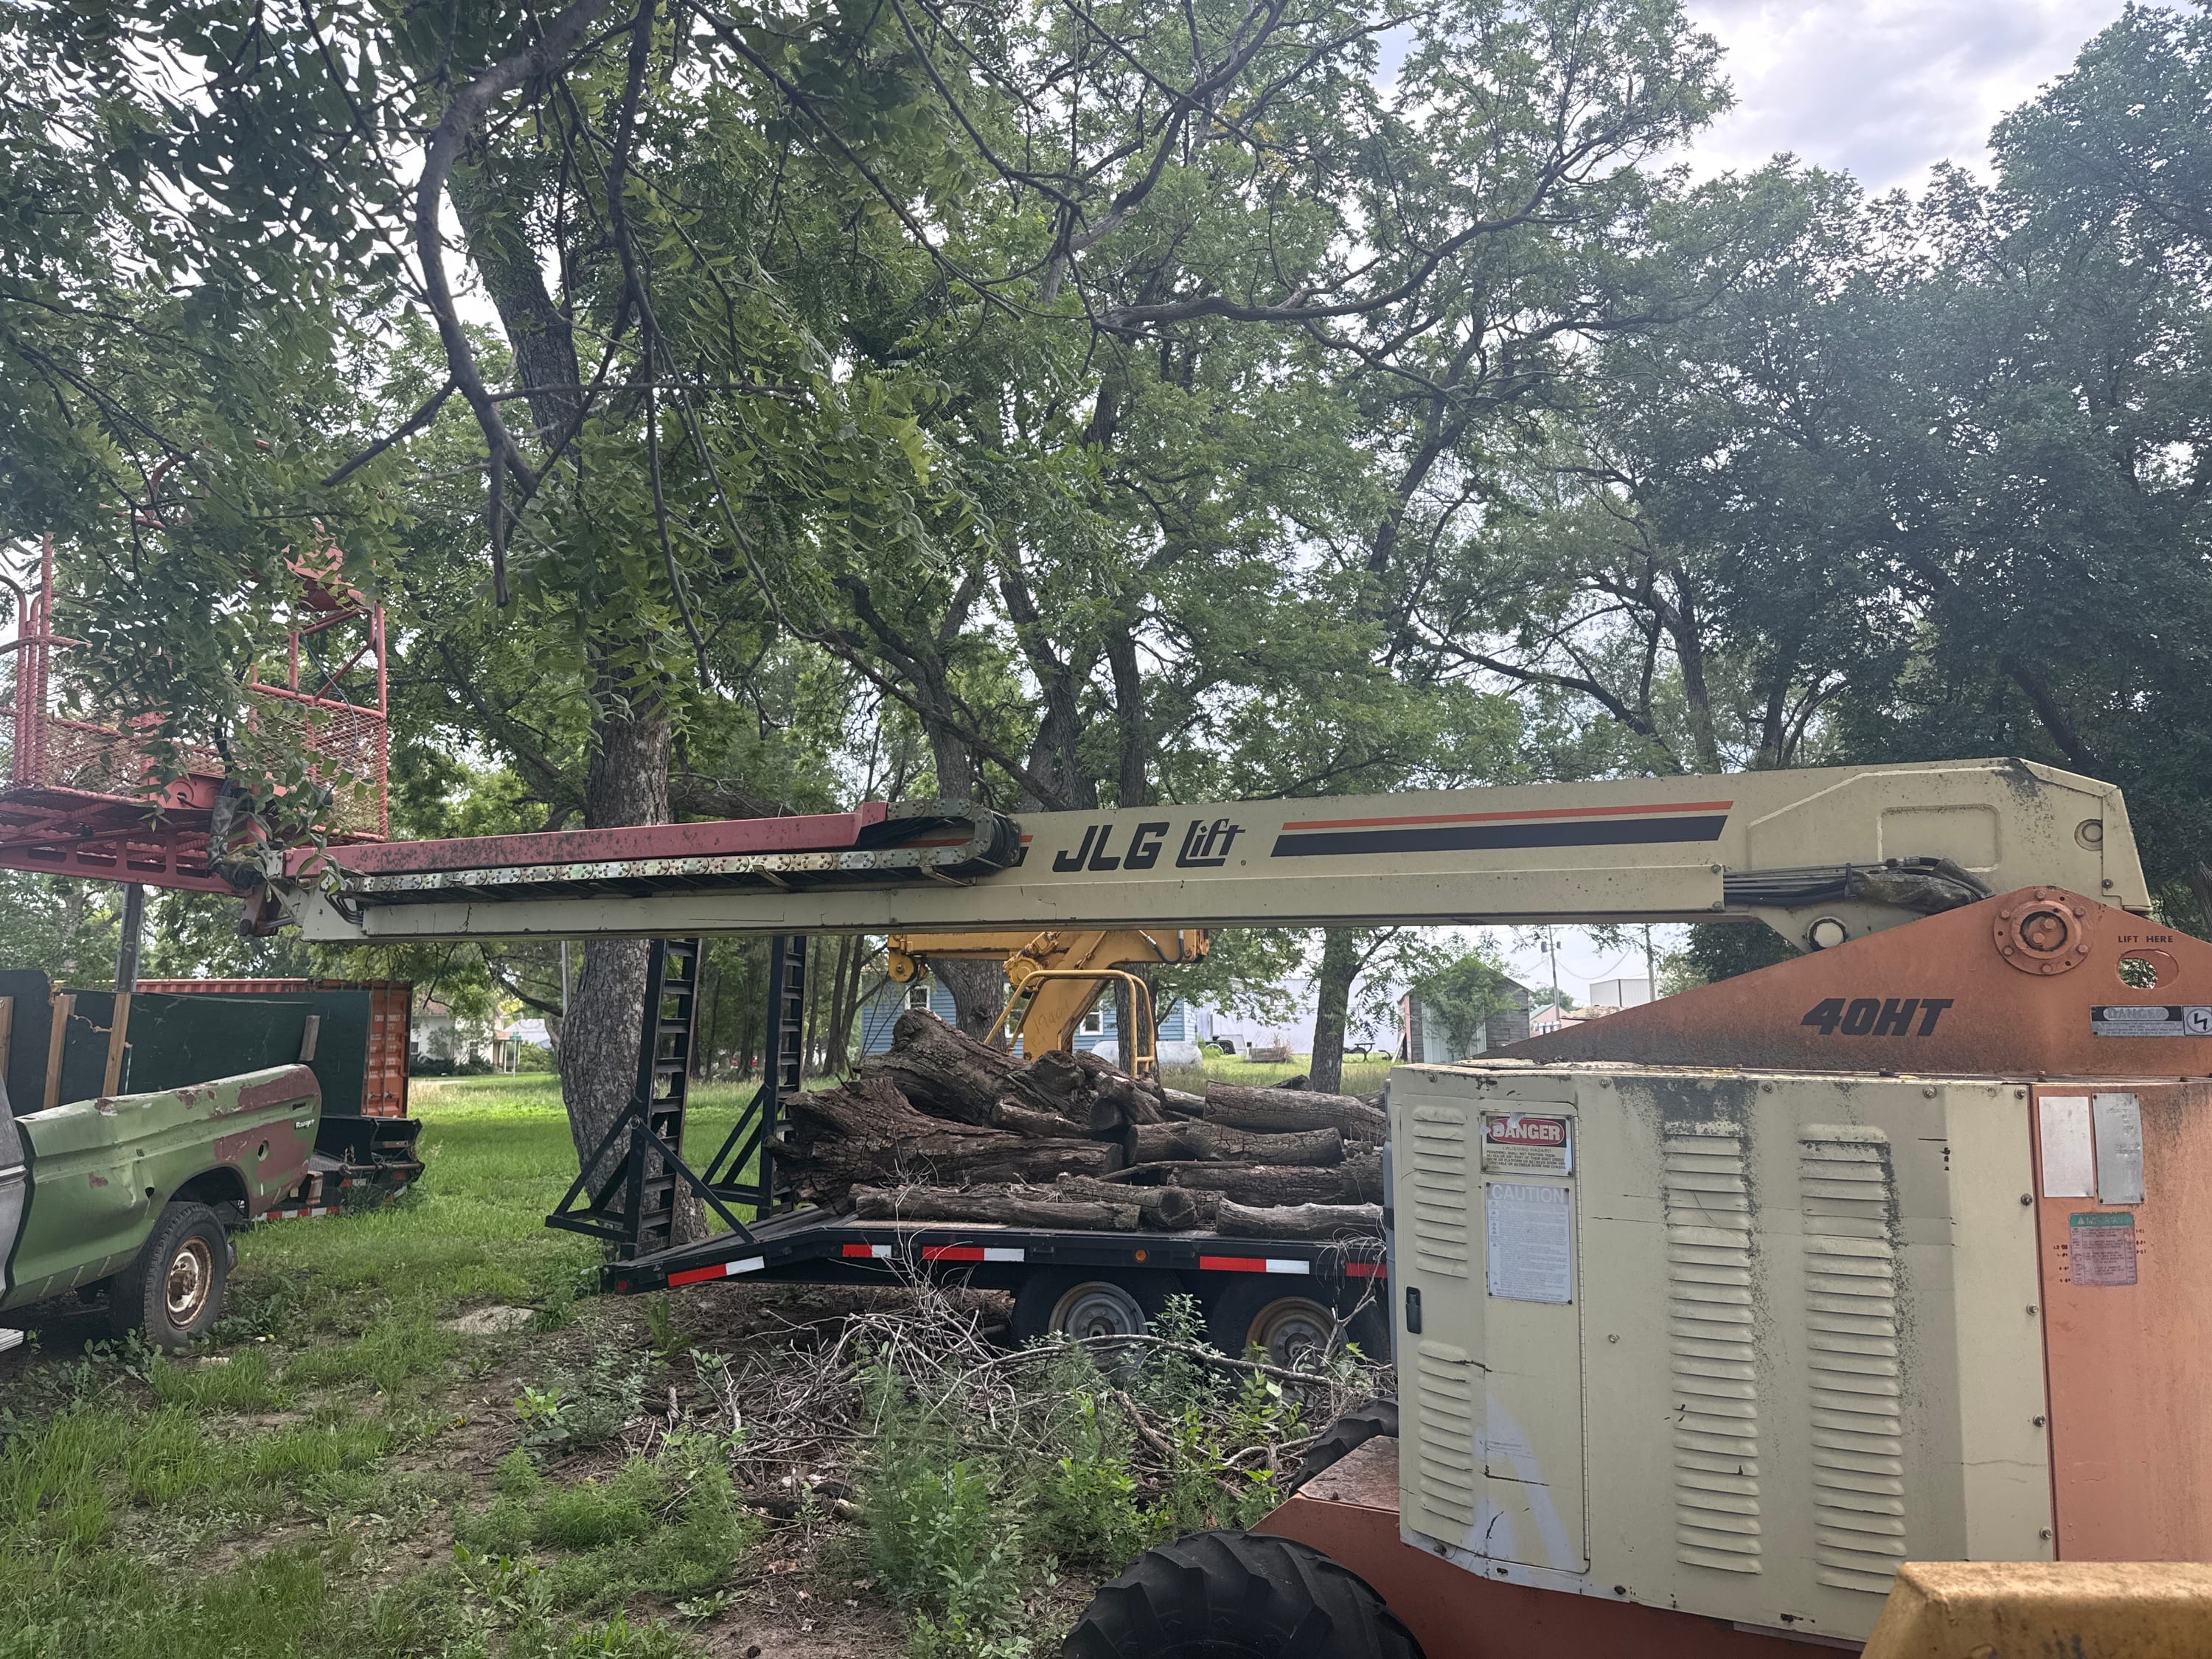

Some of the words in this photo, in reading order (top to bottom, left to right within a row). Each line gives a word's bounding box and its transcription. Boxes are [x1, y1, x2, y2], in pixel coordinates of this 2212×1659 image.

[1052, 821, 1170, 872] JLG
[1175, 818, 1246, 868] Lift
[2118, 935, 2139, 943] LIFT
[2146, 935, 2174, 943] HERE
[1801, 998, 1955, 1036] 40HT
[296, 1119, 315, 1129] Ranger
[1492, 1122, 1561, 1141] DANGER
[1492, 1184, 1564, 1204] CAUTION
